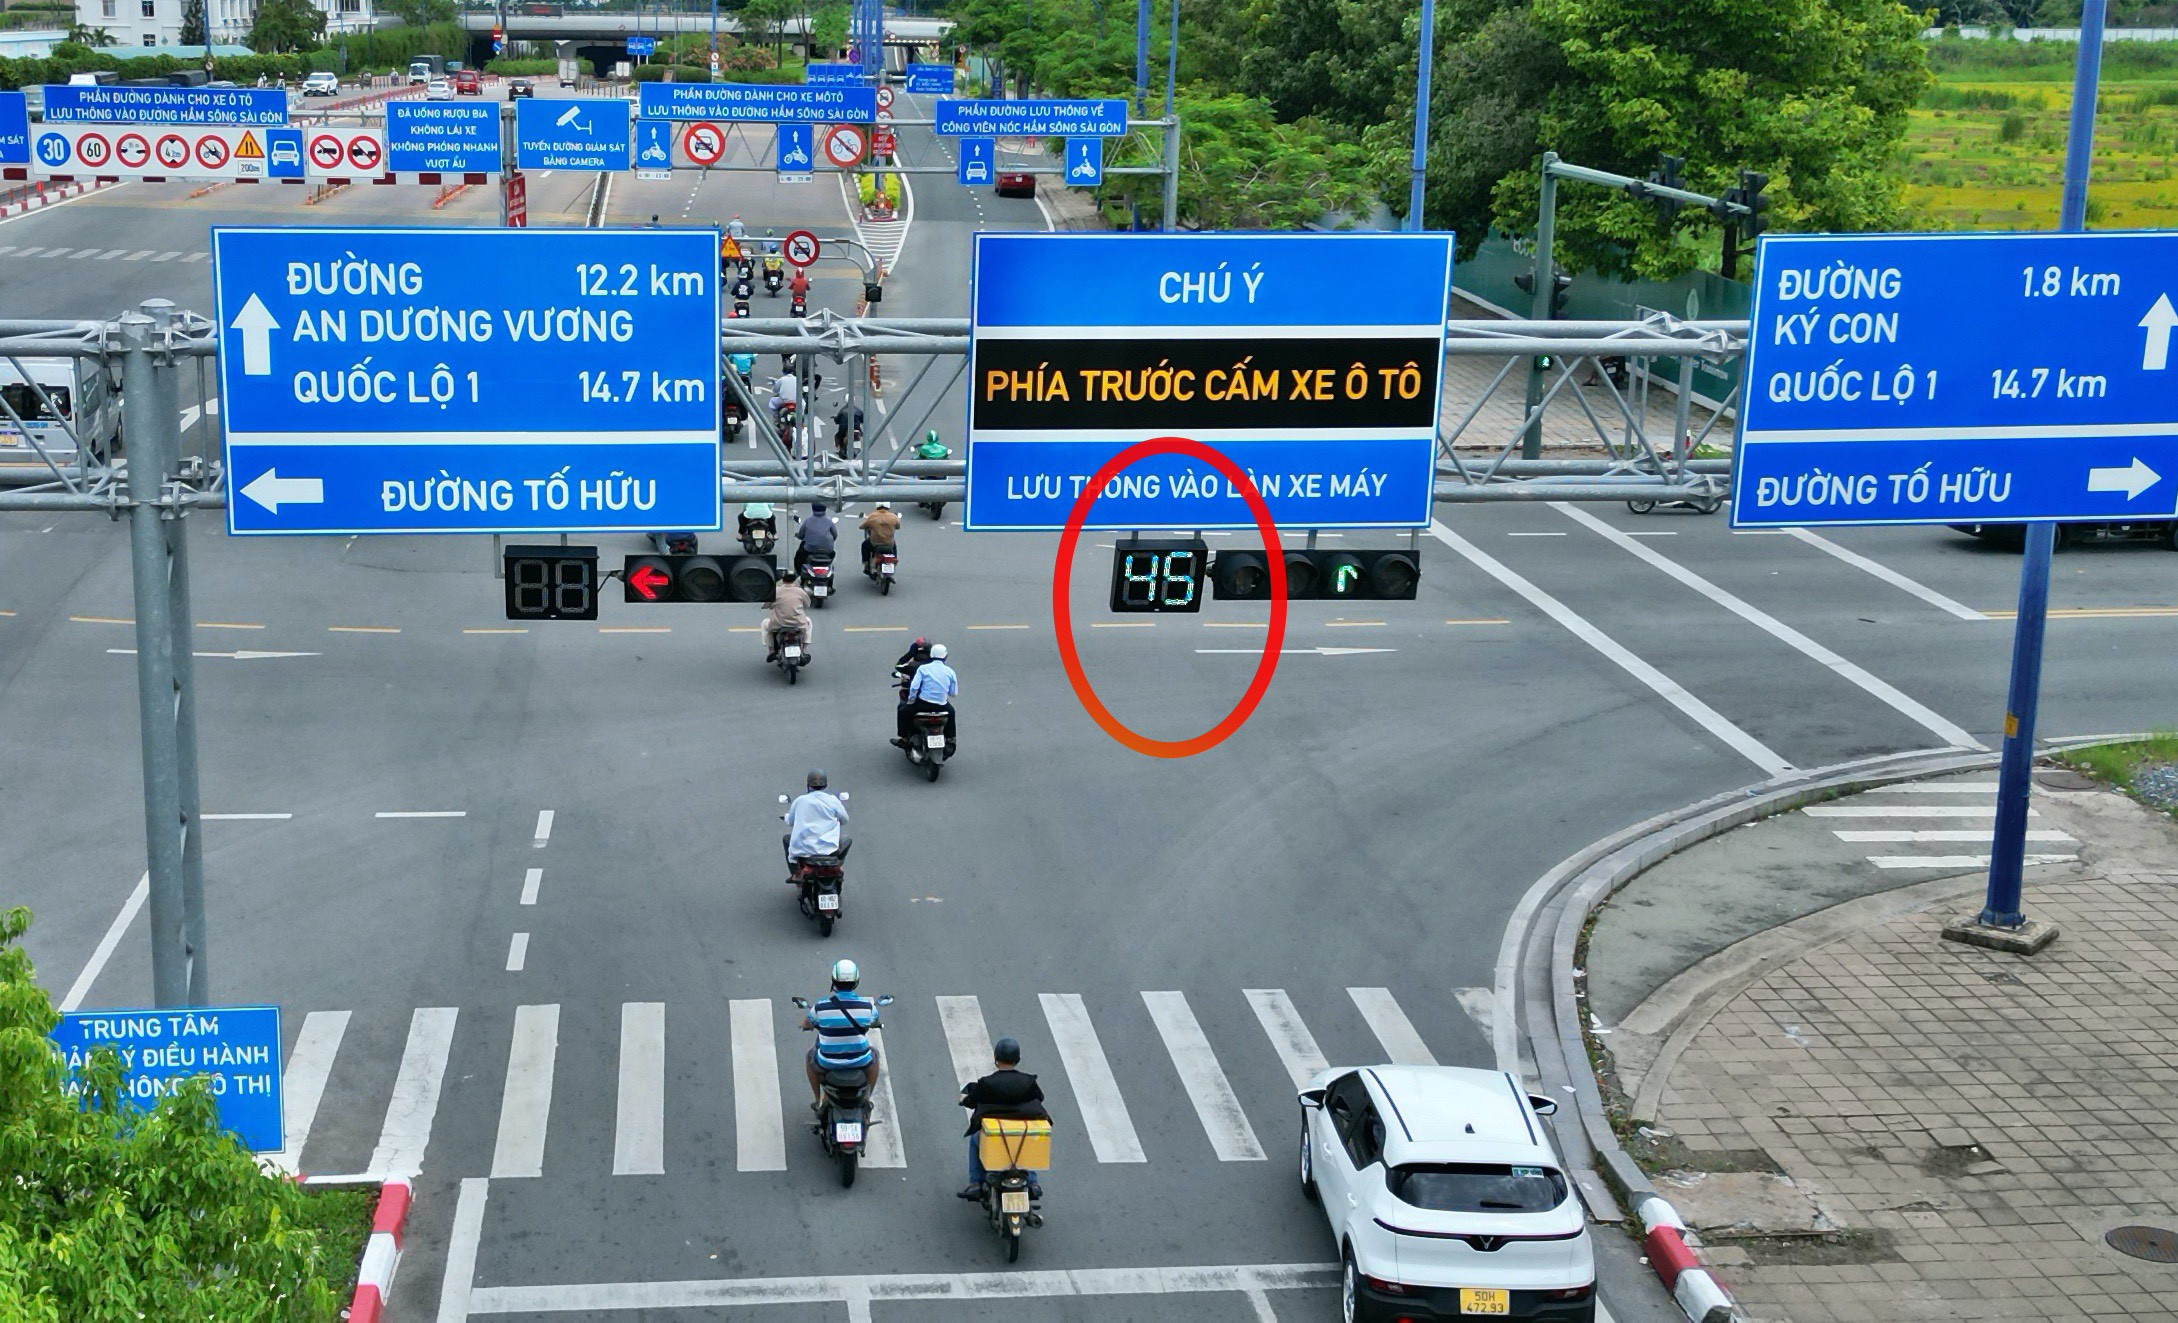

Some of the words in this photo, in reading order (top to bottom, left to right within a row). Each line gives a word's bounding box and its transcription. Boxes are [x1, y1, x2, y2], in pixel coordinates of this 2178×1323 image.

[188, 94, 210, 105] CHO
[213, 95, 226, 105] XE
[229, 93, 236, 105] Ô
[777, 92, 797, 101] CHO
[800, 92, 812, 101] XE
[75, 106, 112, 119] THÔNG
[115, 107, 136, 119] VÀO
[672, 104, 706, 116] THÔNG
[709, 104, 729, 116] VÀO
[1053, 105, 1088, 116] THÔNG
[411, 123, 444, 134] KHÔNG
[465, 126, 477, 135] XE
[942, 121, 970, 132] CÔNG
[44, 139, 64, 160] 30
[87, 143, 100, 157] 60
[392, 141, 424, 151] KHÔNG
[463, 143, 498, 151] NHANH
[570, 157, 605, 166] CAMERA
[287, 251, 422, 295] ĐƯỜNG
[577, 264, 638, 295] 12.2
[651, 264, 703, 295] km
[1160, 262, 1231, 303] CHÚ
[1243, 262, 1264, 303] Ý
[1779, 260, 1901, 300] ĐƯỜNG
[2023, 266, 2061, 297] 1.8
[2071, 267, 2120, 296] km
[293, 310, 346, 341] AN
[361, 306, 492, 342] DƯƠNG
[503, 306, 633, 342] VƯƠNG
[1775, 307, 1820, 345] KÝ
[1829, 313, 1898, 344] CON
[294, 357, 396, 403] QUỐC
[408, 363, 454, 409] LỘ
[467, 372, 478, 402] 1
[579, 371, 640, 402] 14.7
[653, 371, 704, 402] km
[988, 362, 1069, 401] PHÍA
[1080, 359, 1195, 401] TRƯỚC
[1205, 356, 1279, 400] CẤM
[1290, 370, 1335, 400] XE
[1346, 362, 1368, 399] Ô
[1379, 361, 1420, 399] TÔ
[1769, 359, 1862, 402] QUỐC
[1872, 364, 1914, 405] LỘ
[1927, 371, 1936, 399] 1
[1992, 368, 2049, 398] 14.7
[2057, 369, 2106, 397] km
[381, 470, 513, 511] ĐƯỜNG
[524, 466, 570, 510] TỐ
[581, 471, 655, 510] HỮU
[1008, 473, 1061, 499] LƯU
[1169, 468, 1218, 498] VÀO
[1288, 475, 1322, 497] XE
[1330, 468, 1387, 497] MÁY
[1757, 468, 1877, 506] ĐƯỜNG
[1888, 462, 1932, 504] TỐ
[1939, 467, 2011, 503] HỮU
[1125, 551, 1194, 606] 45
[78, 1017, 162, 1040] TRUNG
[168, 1013, 218, 1036] TÂM
[143, 1041, 195, 1067] ĐIỀU
[203, 1042, 268, 1065] HÀNH
[234, 1075, 270, 1096] THỊ
[1467, 1303, 1504, 1313] 472.93
